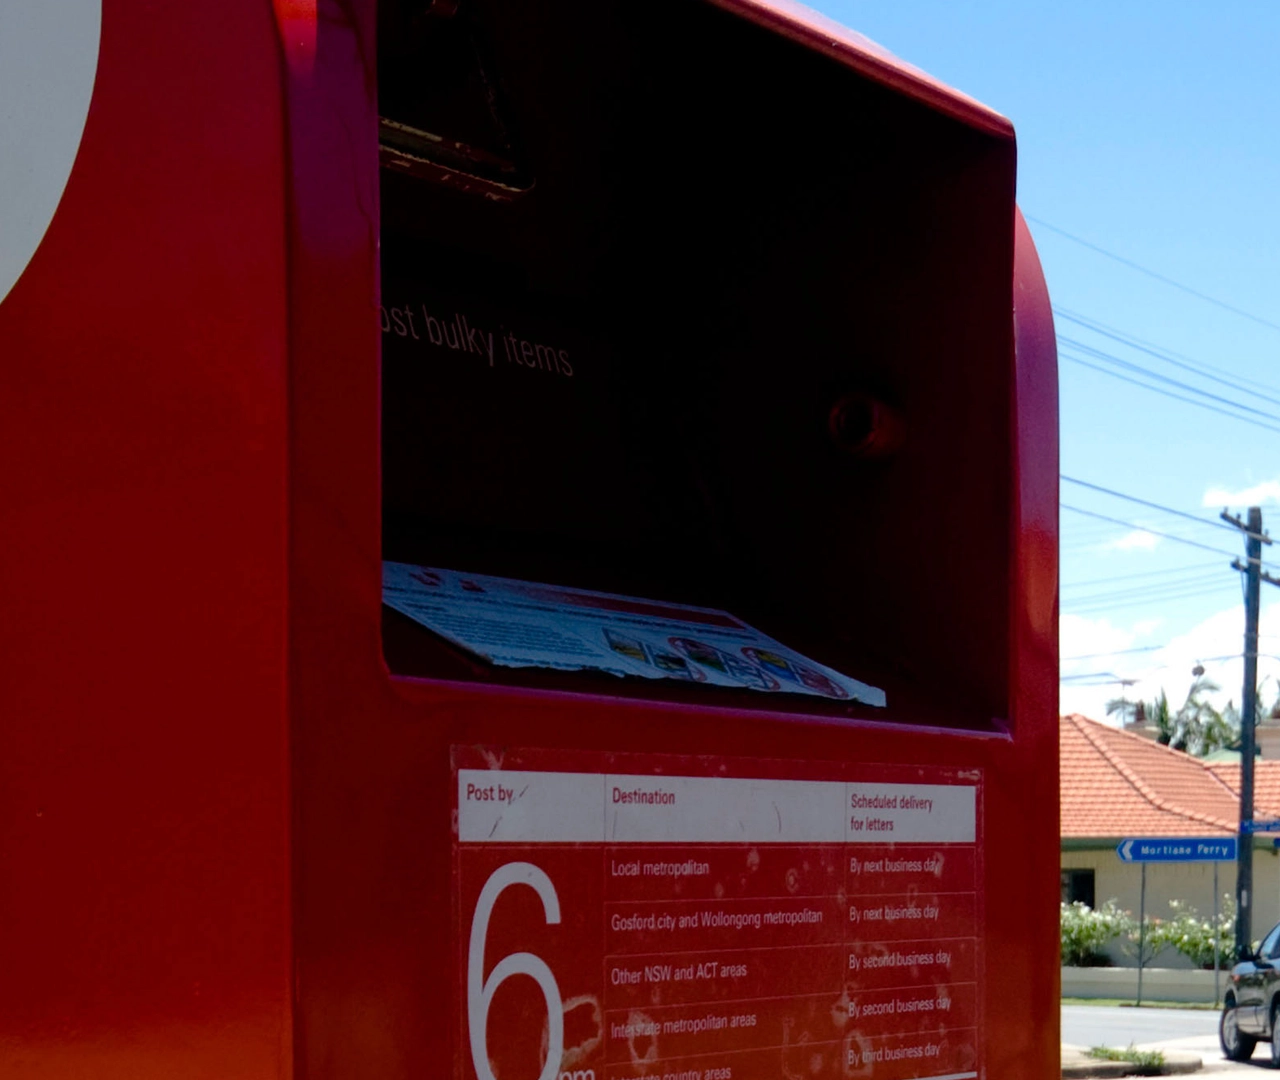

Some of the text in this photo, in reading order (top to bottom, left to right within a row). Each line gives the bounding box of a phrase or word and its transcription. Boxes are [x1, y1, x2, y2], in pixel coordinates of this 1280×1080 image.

[422, 302, 495, 367] bulky
[499, 323, 574, 377] items
[466, 783, 513, 805] Post by
[612, 788, 675, 805] Destination
[851, 794, 933, 813] Scheduled delivery
[850, 817, 894, 832] for letters
[612, 860, 709, 879] Local metropolitan
[850, 858, 940, 875] By next business day
[612, 908, 823, 931] Gosford city and Wollongong metropolitan
[849, 904, 939, 923] By next business day
[849, 949, 951, 970] By second business day
[612, 961, 747, 985] Other NSW and ACT areas
[848, 995, 951, 1018] By second business day
[612, 1015, 757, 1039] Interstate metropolitan areas
[848, 1043, 940, 1066] By third business day
